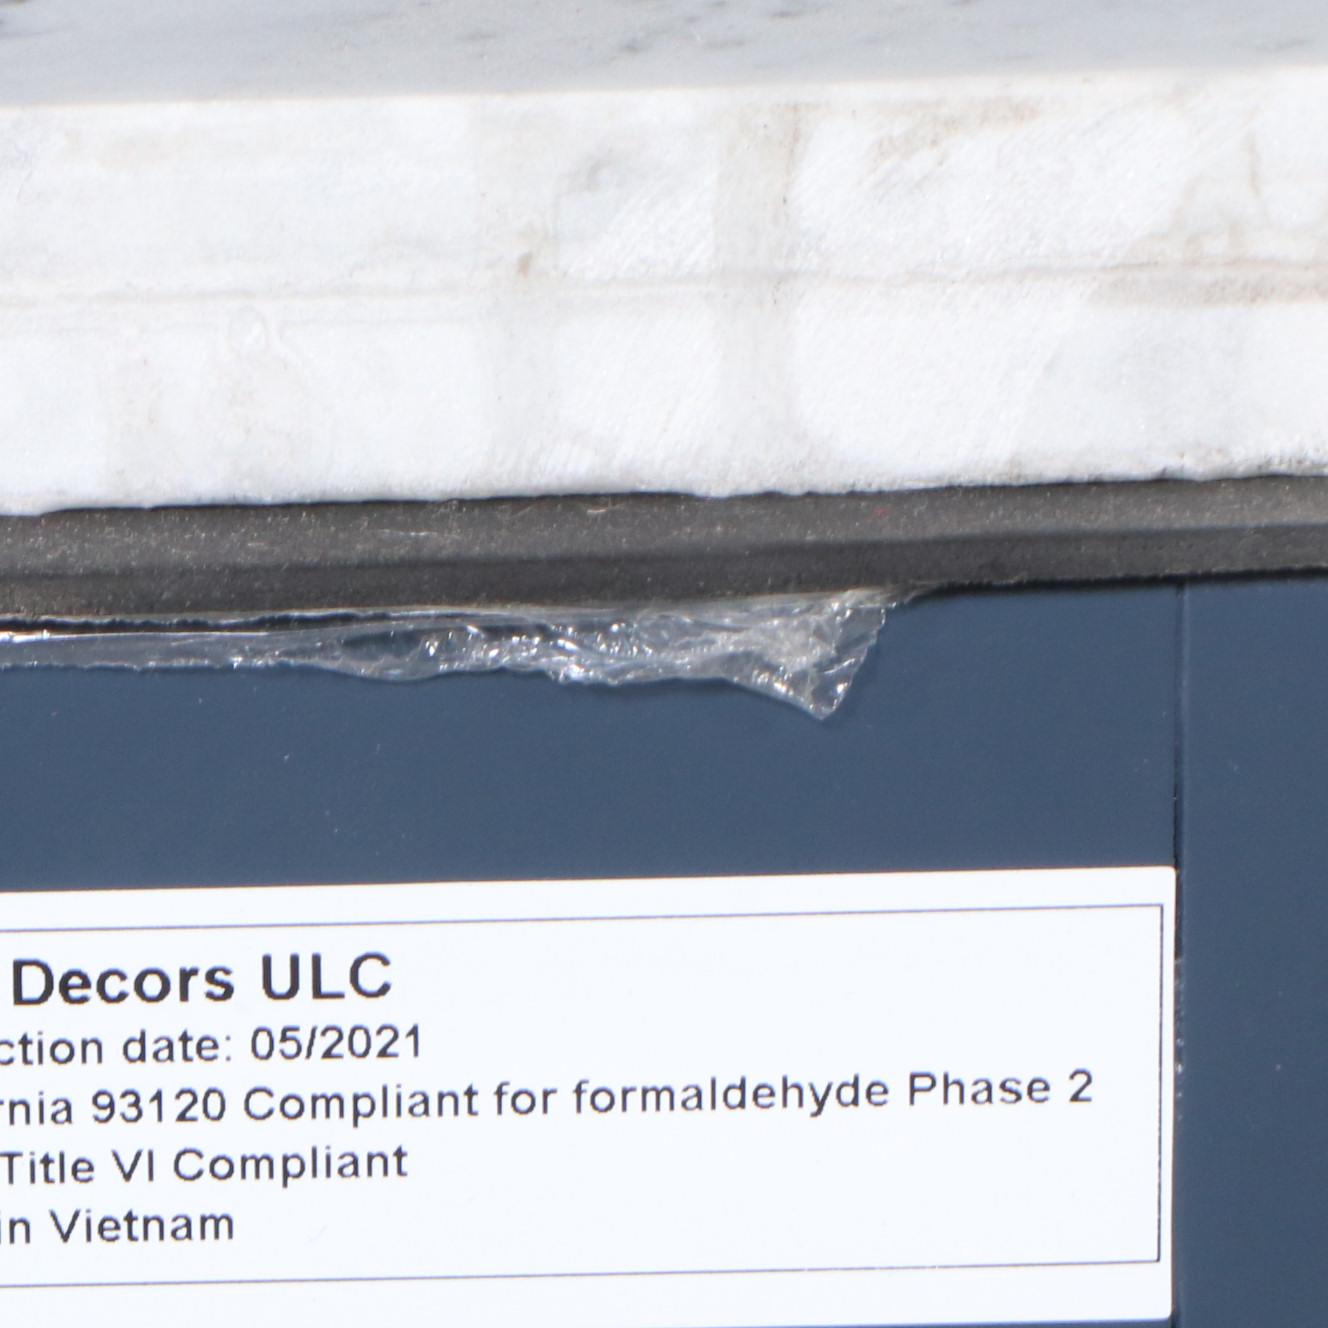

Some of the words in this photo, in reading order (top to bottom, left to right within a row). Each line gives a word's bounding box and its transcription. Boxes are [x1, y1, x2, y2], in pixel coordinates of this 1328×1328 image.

[13, 959, 235, 1005] Decors
[262, 953, 391, 1000] ULC
[123, 1030, 231, 1063] date:
[252, 1025, 419, 1061] 05/2021
[92, 1089, 226, 1124] 93120
[244, 1085, 478, 1128] Compliant
[494, 1082, 558, 1115] for
[574, 1075, 889, 1118] formaldehyde
[910, 1072, 1051, 1106] Phase
[1069, 1069, 1093, 1103] 2
[0, 1152, 95, 1185] Title
[113, 1150, 154, 1182] VI
[174, 1146, 408, 1188] Compliant
[50, 1210, 234, 1243] Vietnam
